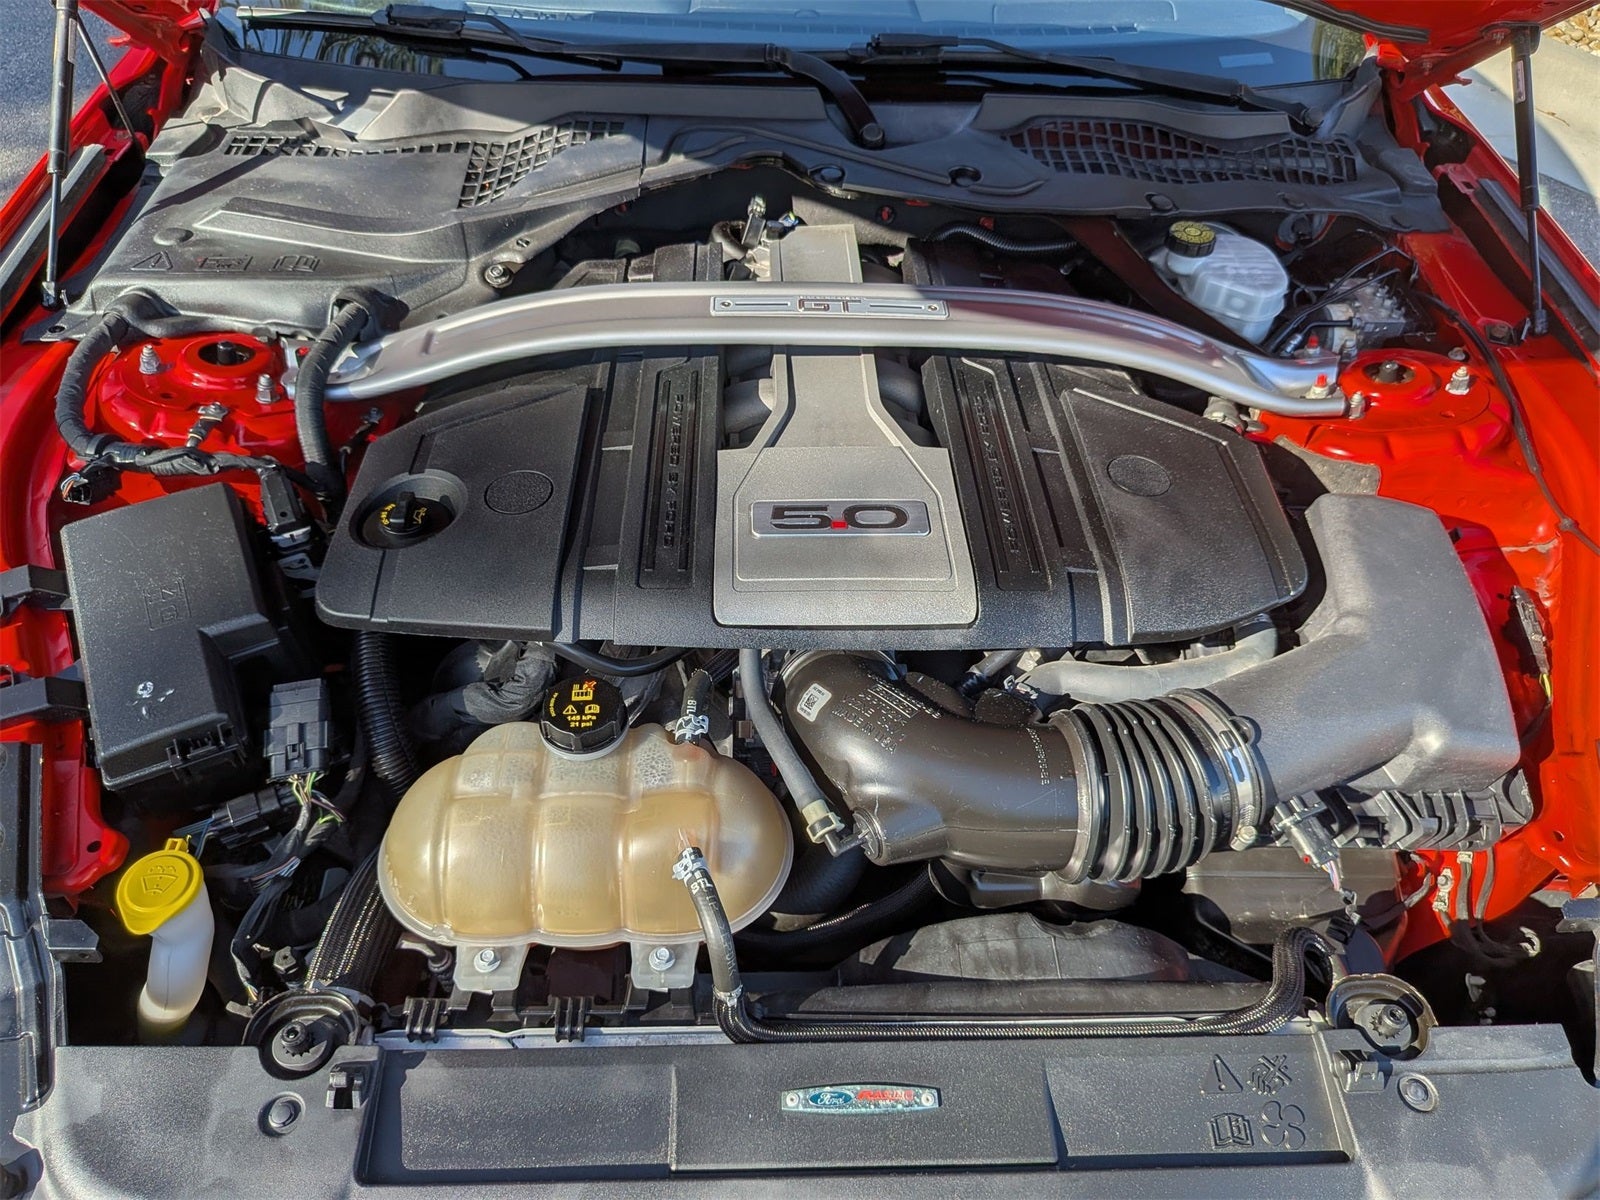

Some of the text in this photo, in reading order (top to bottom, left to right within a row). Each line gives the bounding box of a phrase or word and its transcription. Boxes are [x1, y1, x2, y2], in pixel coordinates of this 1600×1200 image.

[798, 298, 862, 313] GT
[663, 394, 684, 548] POWERED BY FORD
[770, 504, 909, 529] 5.0
[873, 730, 898, 754] USA
[817, 1089, 914, 1105] Ford RACING
